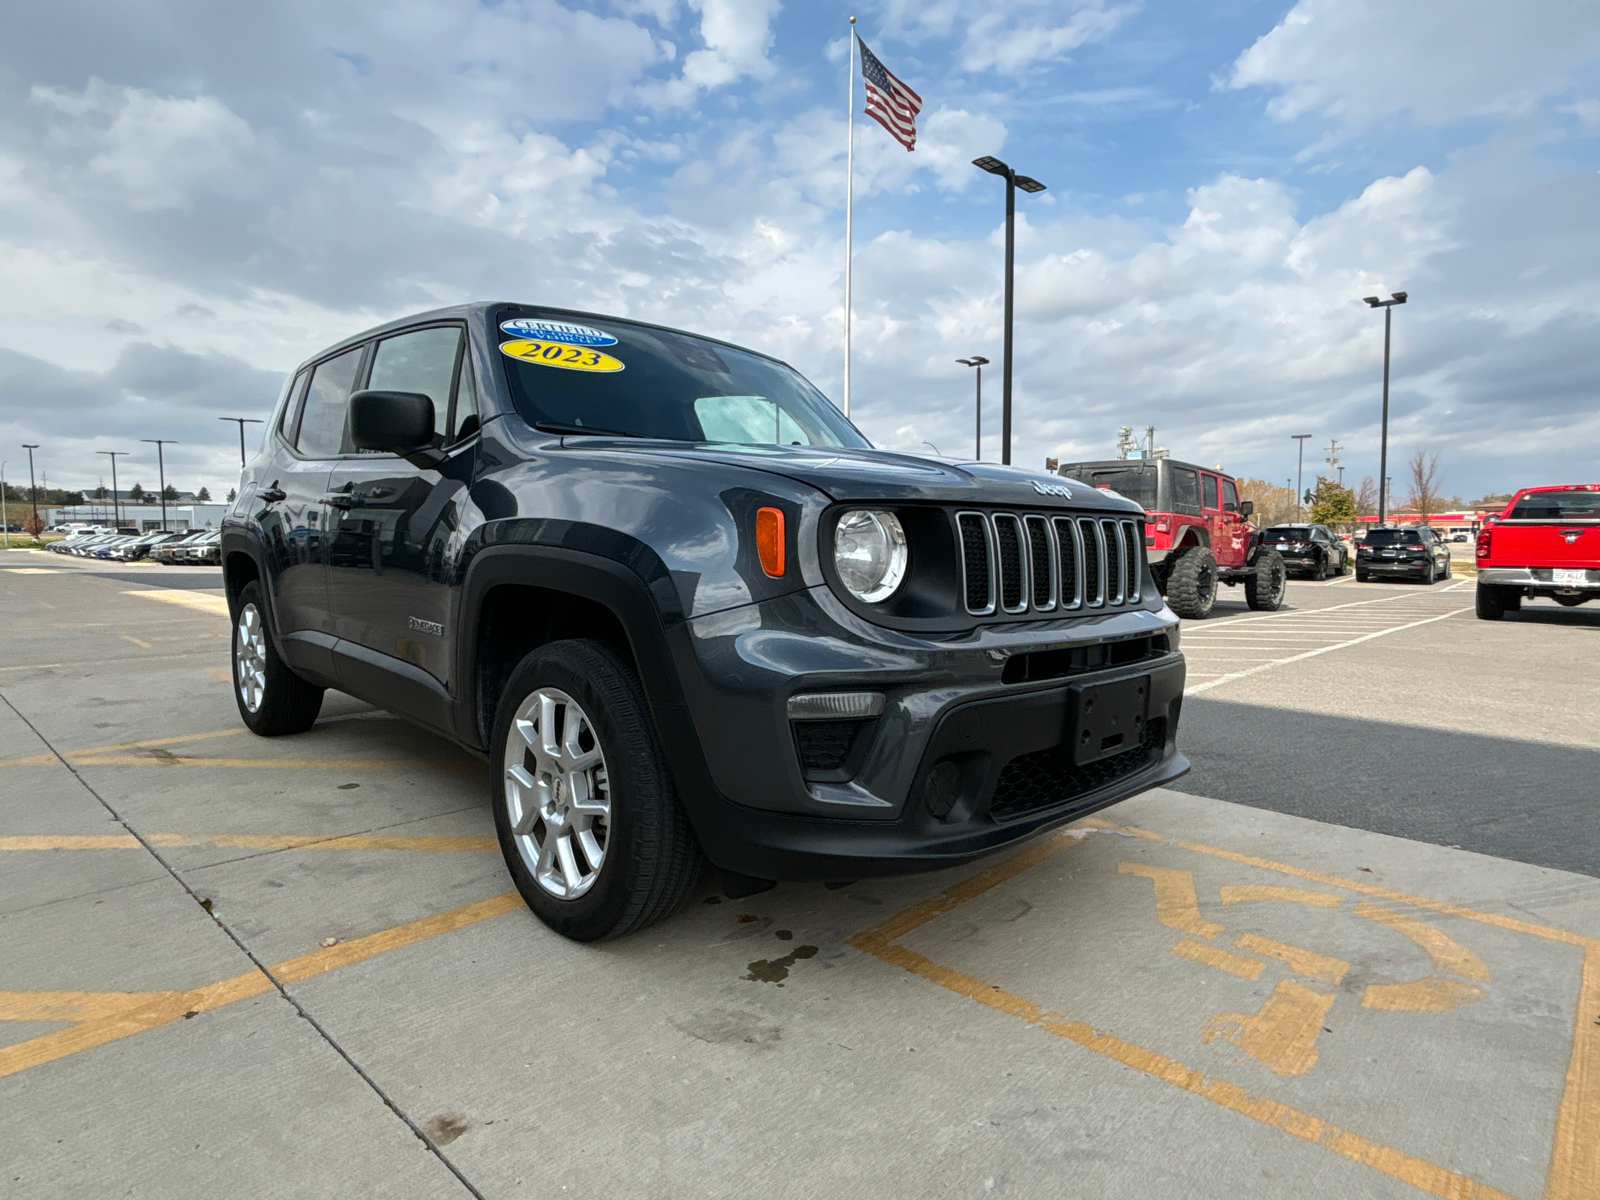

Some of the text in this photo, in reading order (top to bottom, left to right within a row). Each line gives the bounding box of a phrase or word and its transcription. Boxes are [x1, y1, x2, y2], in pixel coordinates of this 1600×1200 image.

[513, 320, 602, 337] CERTIFIED
[521, 329, 602, 342] PRE-OWNED
[535, 334, 594, 344] VEHICLE
[519, 343, 602, 366] 2023
[1031, 480, 1072, 500] Jeep
